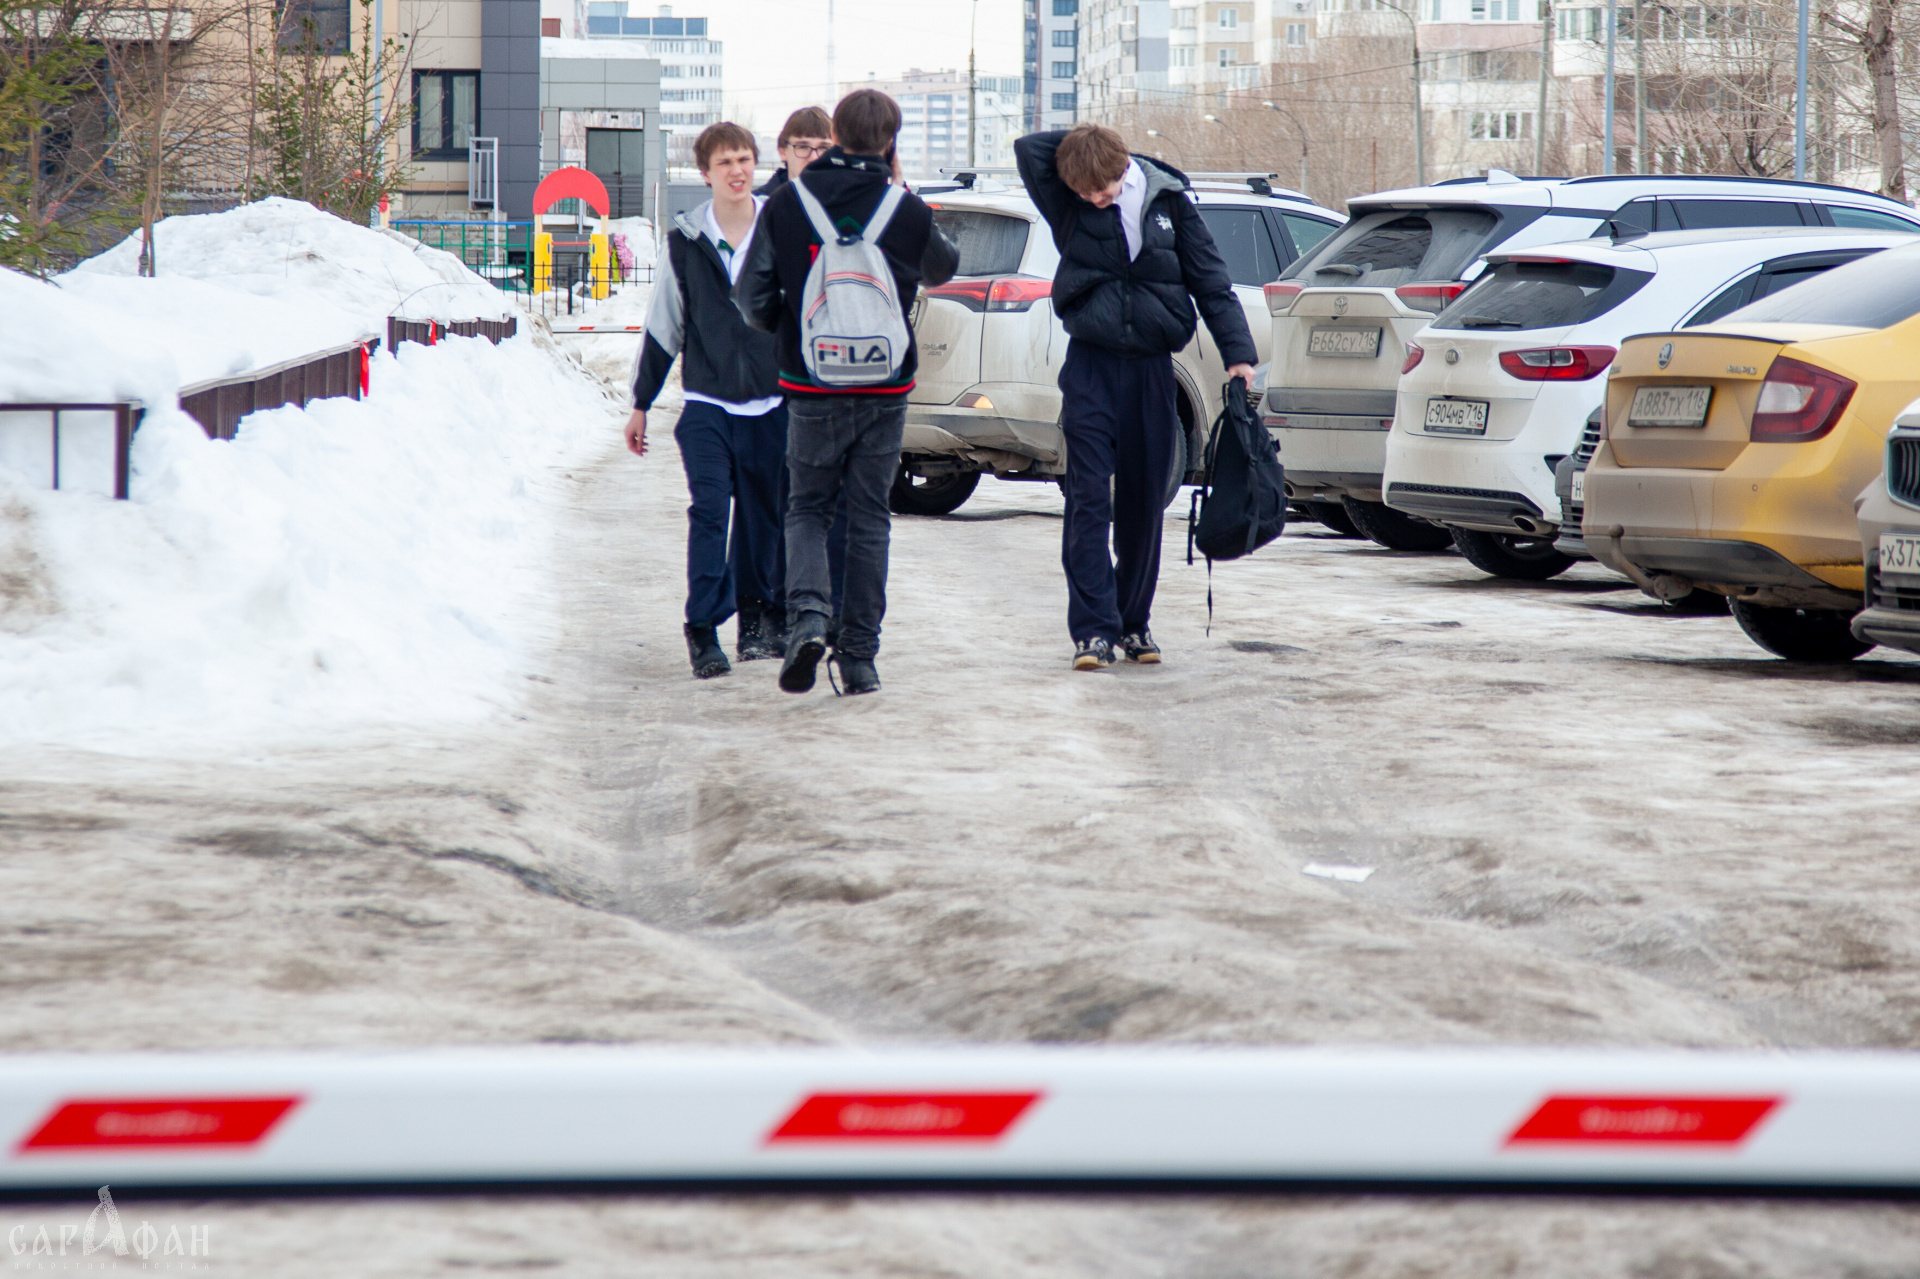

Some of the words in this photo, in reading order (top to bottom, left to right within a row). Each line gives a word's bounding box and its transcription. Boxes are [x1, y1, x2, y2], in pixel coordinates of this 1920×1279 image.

[817, 343, 887, 363] FILA
[1428, 403, 1464, 425] С904МВ
[1466, 403, 1483, 421] 716
